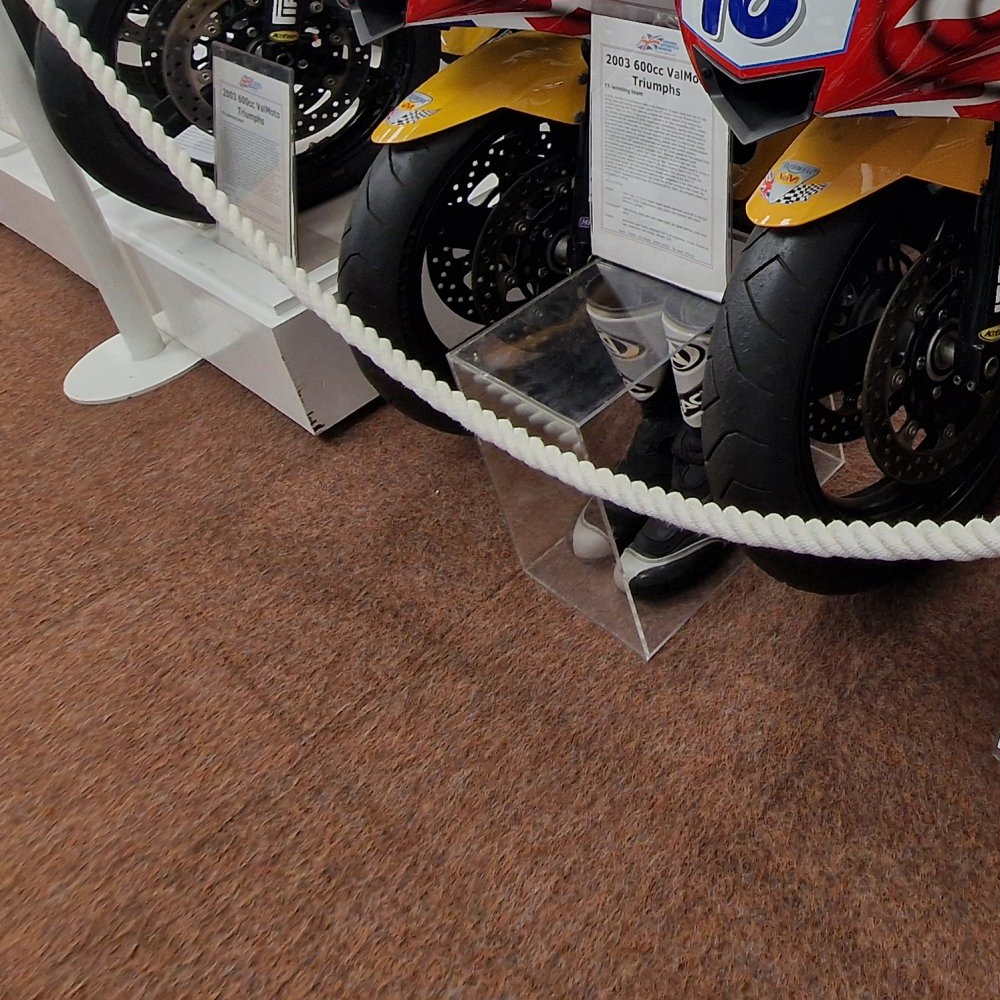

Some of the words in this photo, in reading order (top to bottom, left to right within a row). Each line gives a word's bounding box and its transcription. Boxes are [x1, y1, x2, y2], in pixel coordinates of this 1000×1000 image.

[605, 53, 631, 69] 2003
[633, 59, 664, 76] 600cc
[667, 66, 700, 84] ValMo
[632, 75, 681, 97] Triumphs
[237, 106, 265, 126] Triumphs
